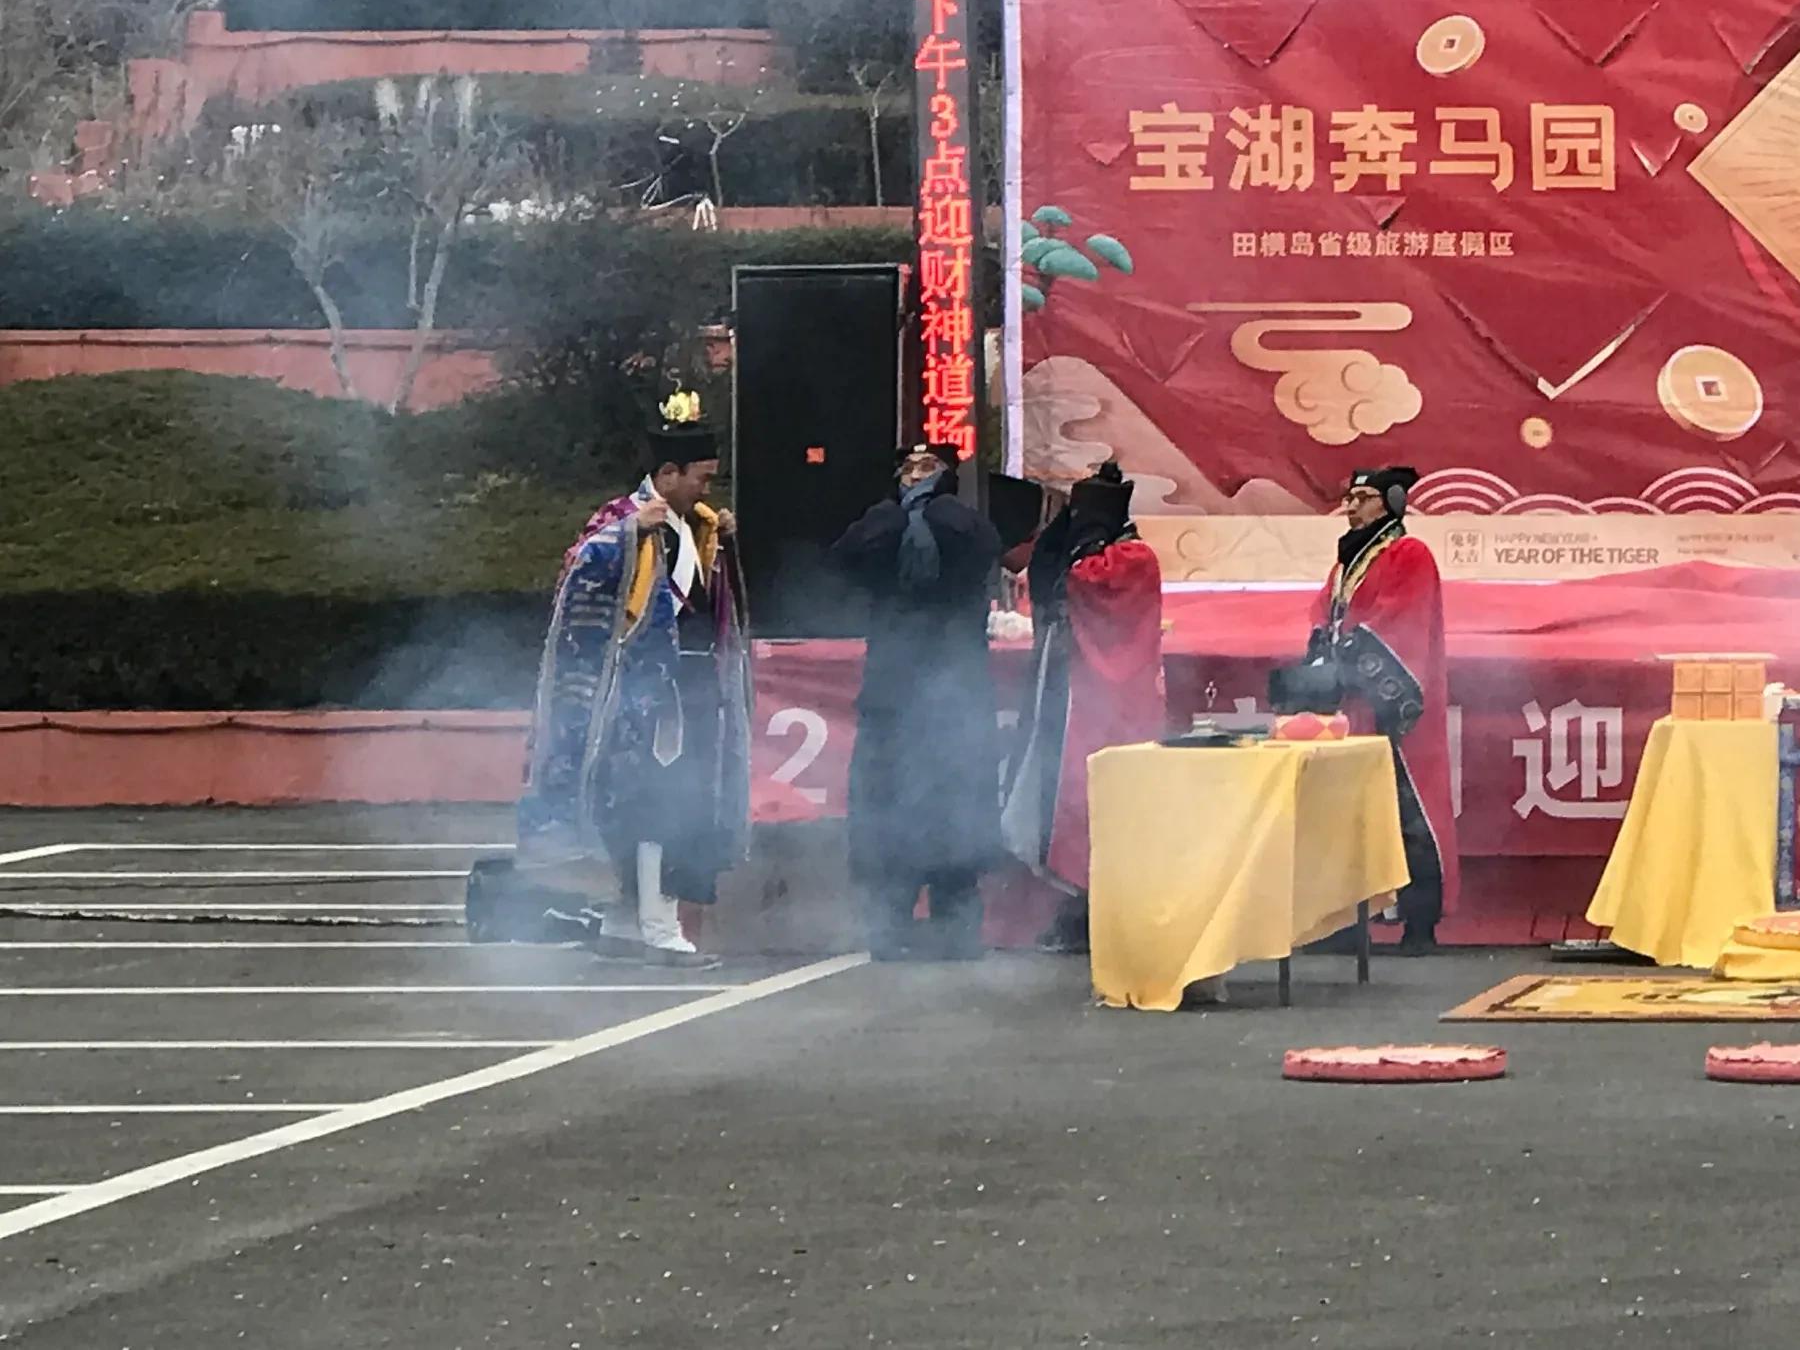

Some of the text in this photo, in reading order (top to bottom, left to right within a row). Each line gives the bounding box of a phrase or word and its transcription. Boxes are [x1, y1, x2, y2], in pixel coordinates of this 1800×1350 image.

[1128, 102, 1617, 192] 宝湖奔马园
[1232, 231, 1515, 258] 田横岛省级旅游度假区
[1494, 548, 1541, 564] YEAR
[1543, 548, 1568, 564] OF
[1569, 548, 1605, 564] THE
[1606, 548, 1660, 565] TIGER
[765, 707, 829, 804] 2
